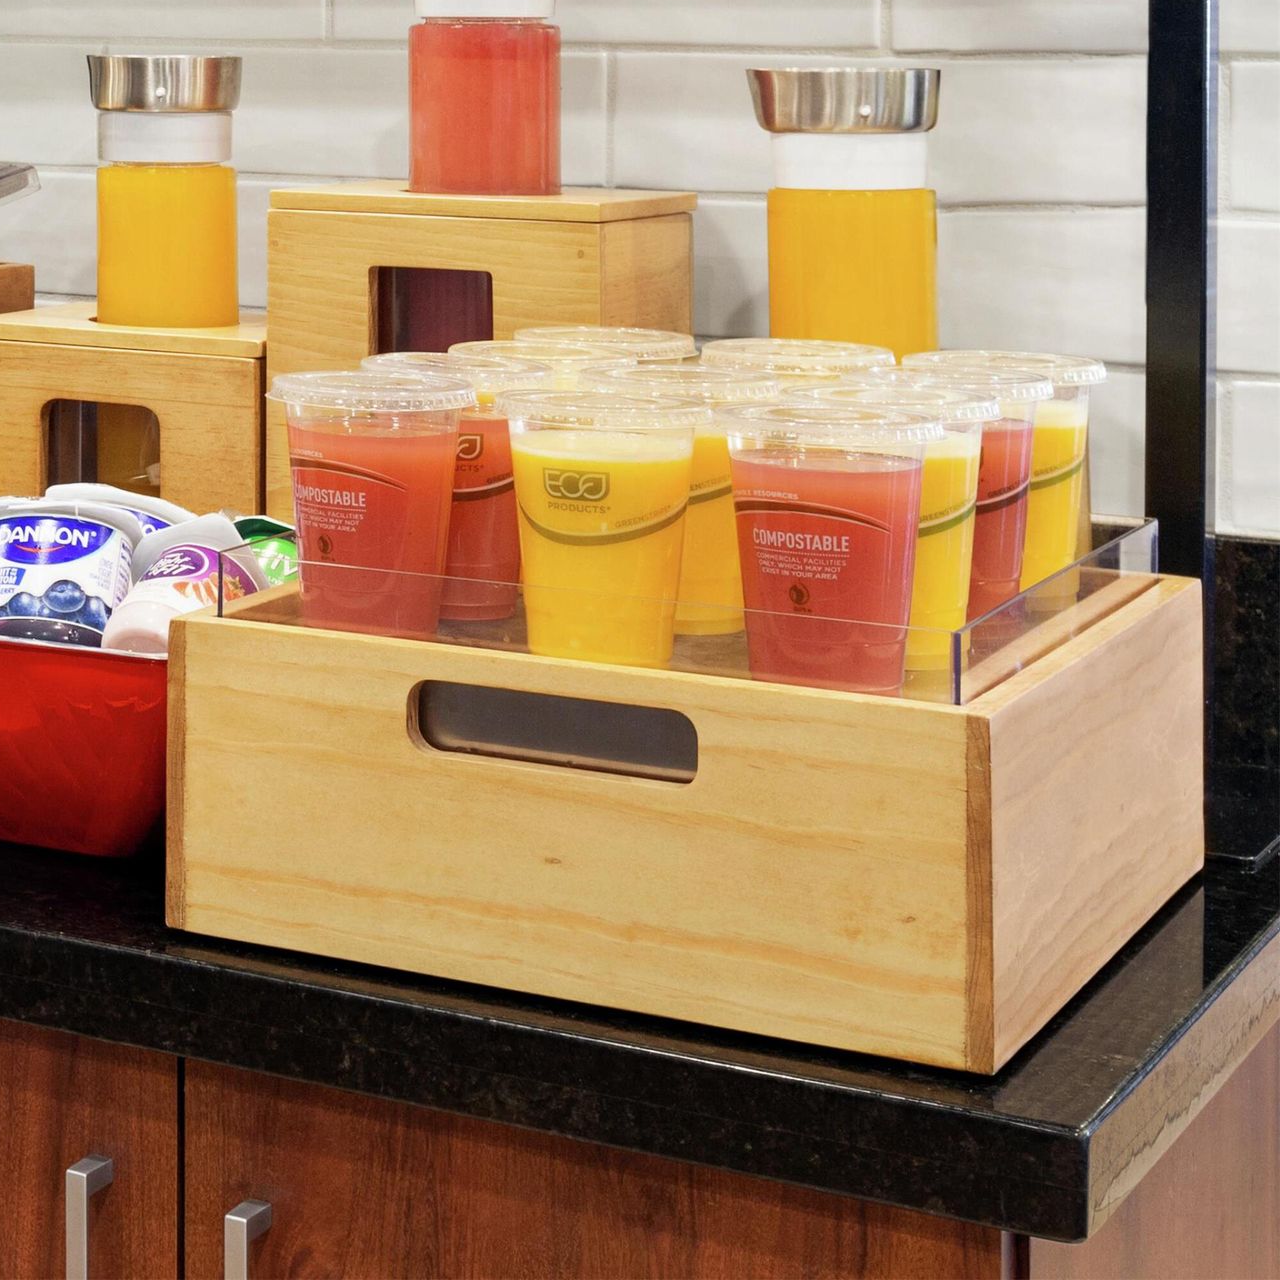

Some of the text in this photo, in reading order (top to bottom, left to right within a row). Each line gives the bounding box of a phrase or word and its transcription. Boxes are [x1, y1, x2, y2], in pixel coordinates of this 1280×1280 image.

[545, 469, 607, 500] ECO
[547, 500, 605, 514] PRODUCTS
[753, 527, 850, 552] COMPOSTABLE
[803, 558, 847, 567] FACILITIES
[791, 570, 813, 578] YOUR
[815, 572, 838, 581] AREA
